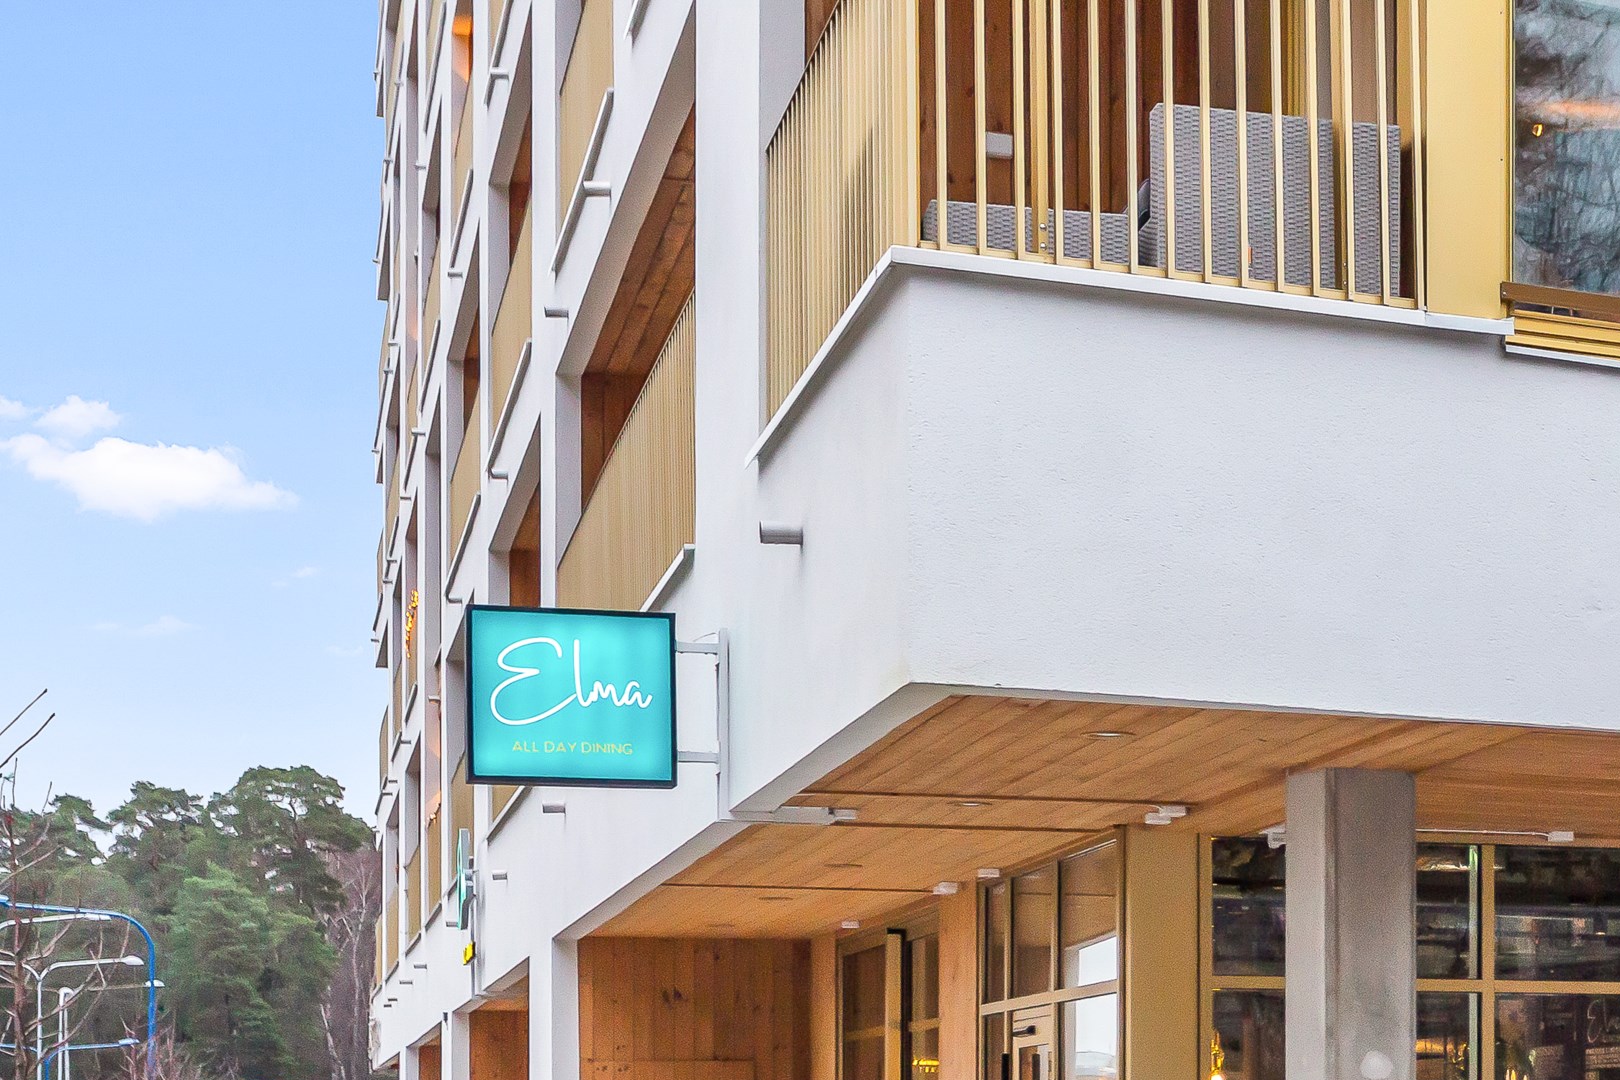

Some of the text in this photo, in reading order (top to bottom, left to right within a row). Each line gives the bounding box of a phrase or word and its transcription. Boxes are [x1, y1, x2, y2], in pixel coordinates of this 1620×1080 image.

[490, 637, 653, 726] Elma
[512, 740, 633, 755] ALL DAY DINING
